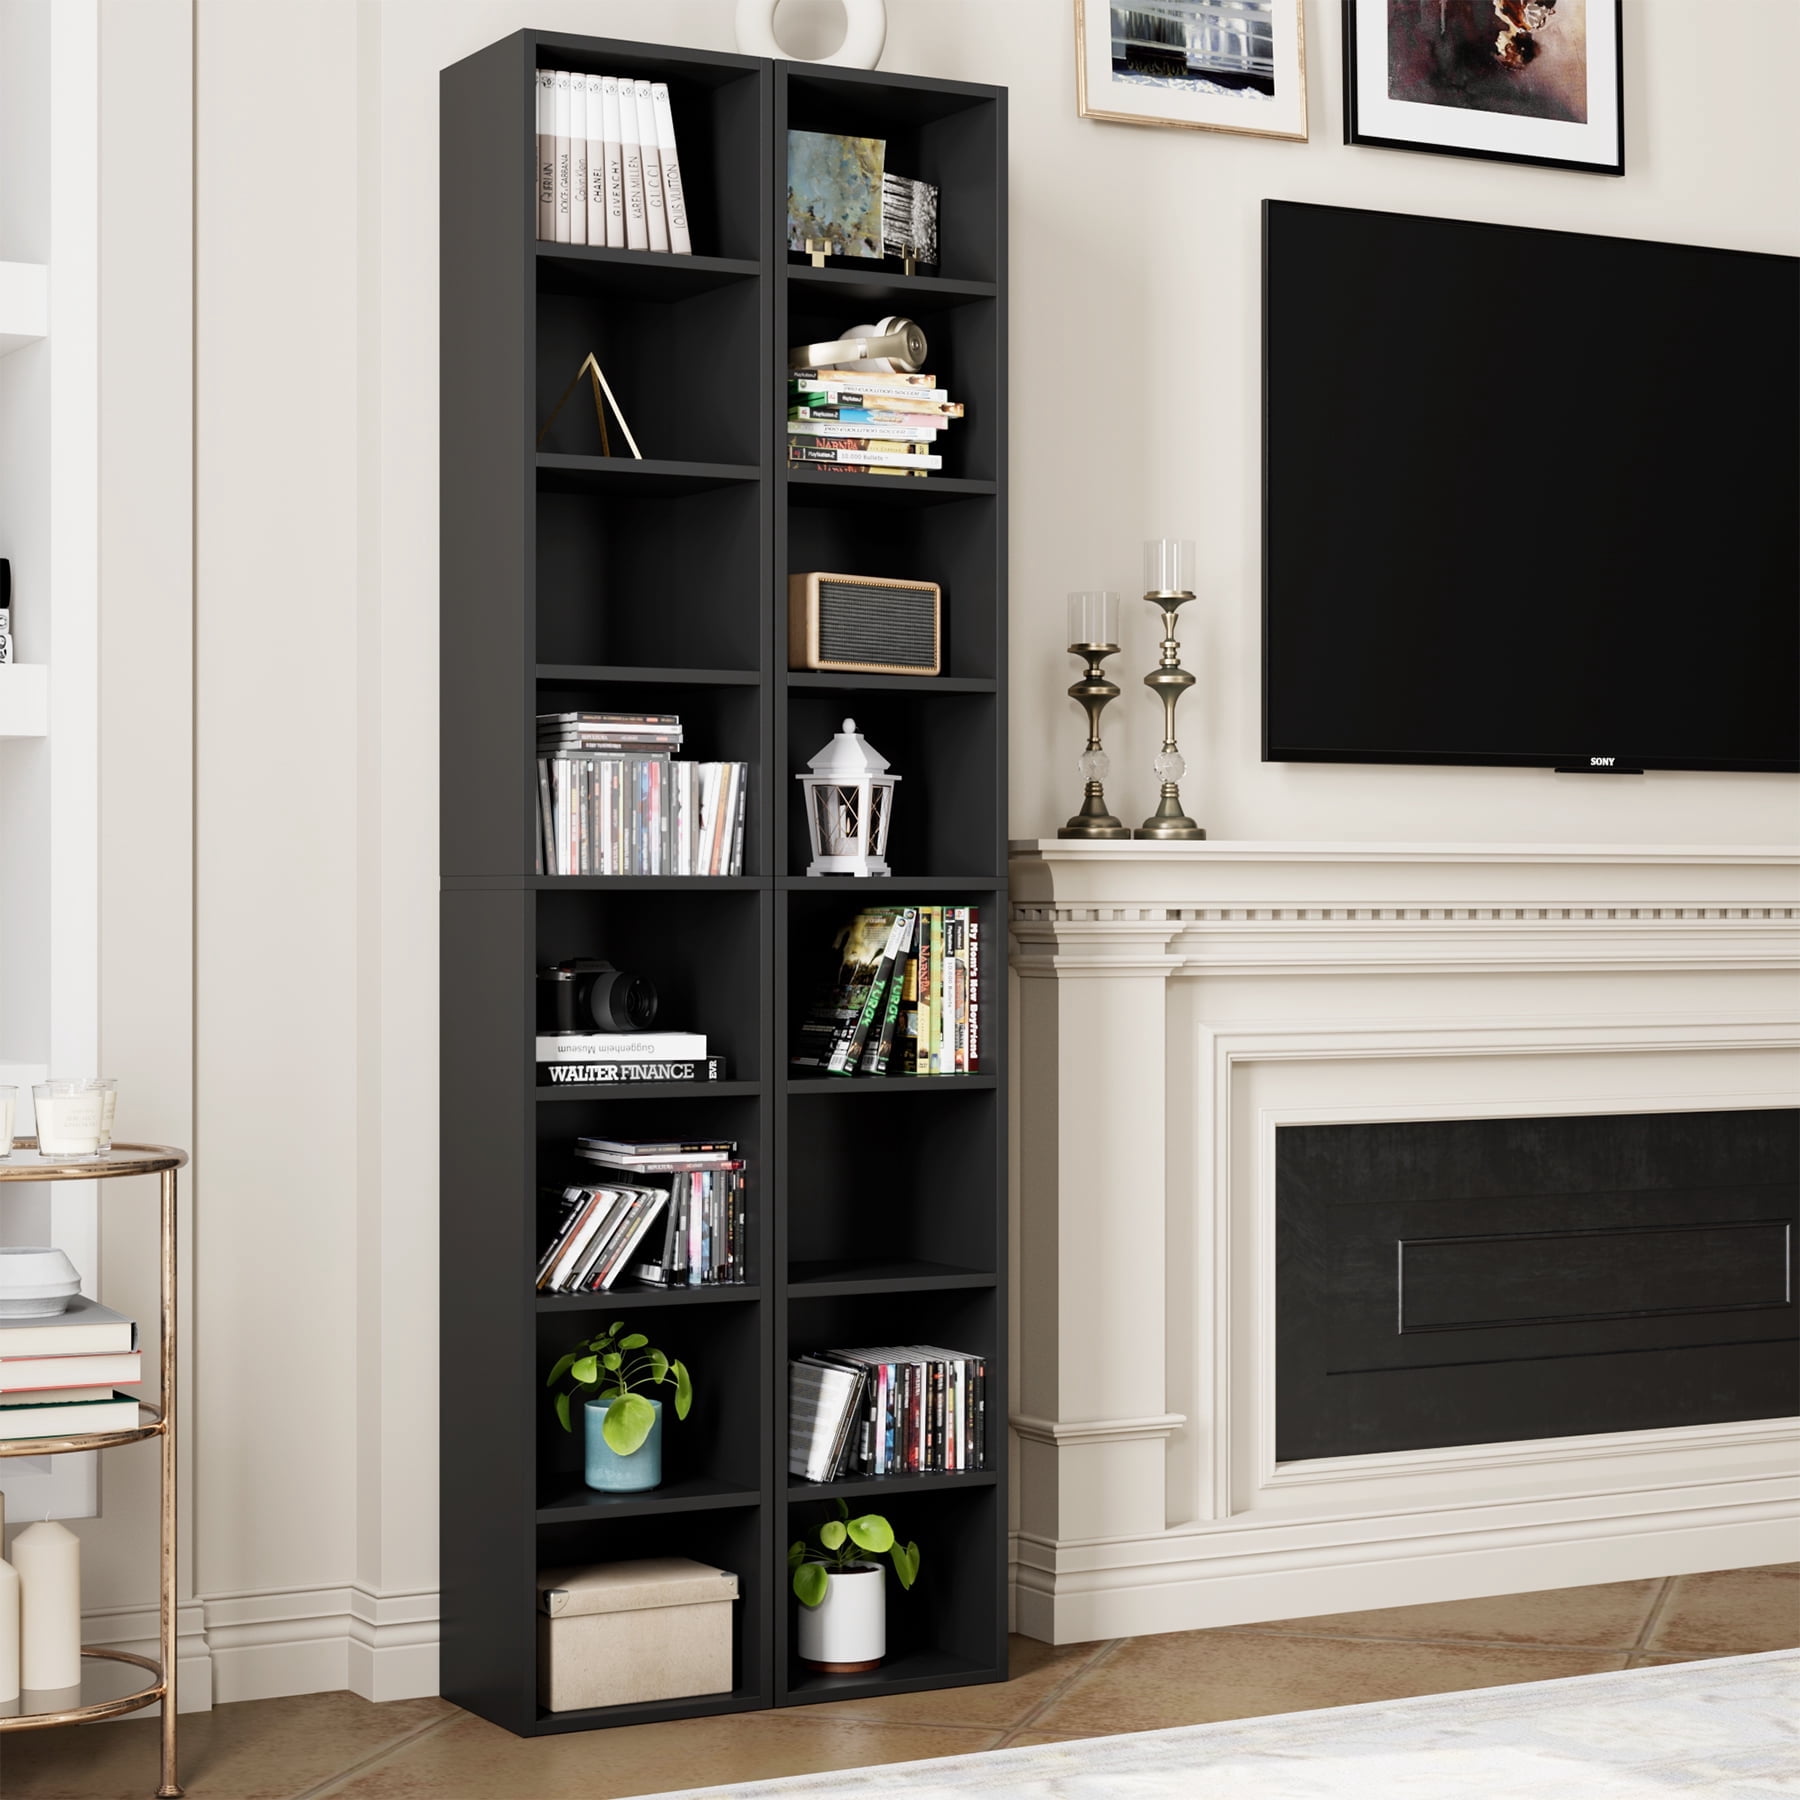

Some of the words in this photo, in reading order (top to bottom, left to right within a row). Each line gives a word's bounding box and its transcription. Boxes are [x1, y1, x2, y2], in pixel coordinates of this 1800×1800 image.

[593, 167, 602, 203] CHANEL
[628, 156, 641, 190] MILLEN
[666, 163, 682, 202] VUITTON
[611, 160, 622, 217] GIVENCHY
[631, 191, 643, 220] KAREN
[671, 204, 686, 229] LOUIS
[1590, 757, 1616, 767] SONY
[969, 922, 979, 941] My
[969, 941, 979, 977] Mom's
[969, 979, 979, 1002] New
[969, 1003, 979, 1059] Boyfriend
[557, 1044, 597, 1054] Museum
[598, 1044, 655, 1054] Guggenheim
[548, 1065, 619, 1082] WALTER
[620, 1063, 695, 1080] FINANCE
